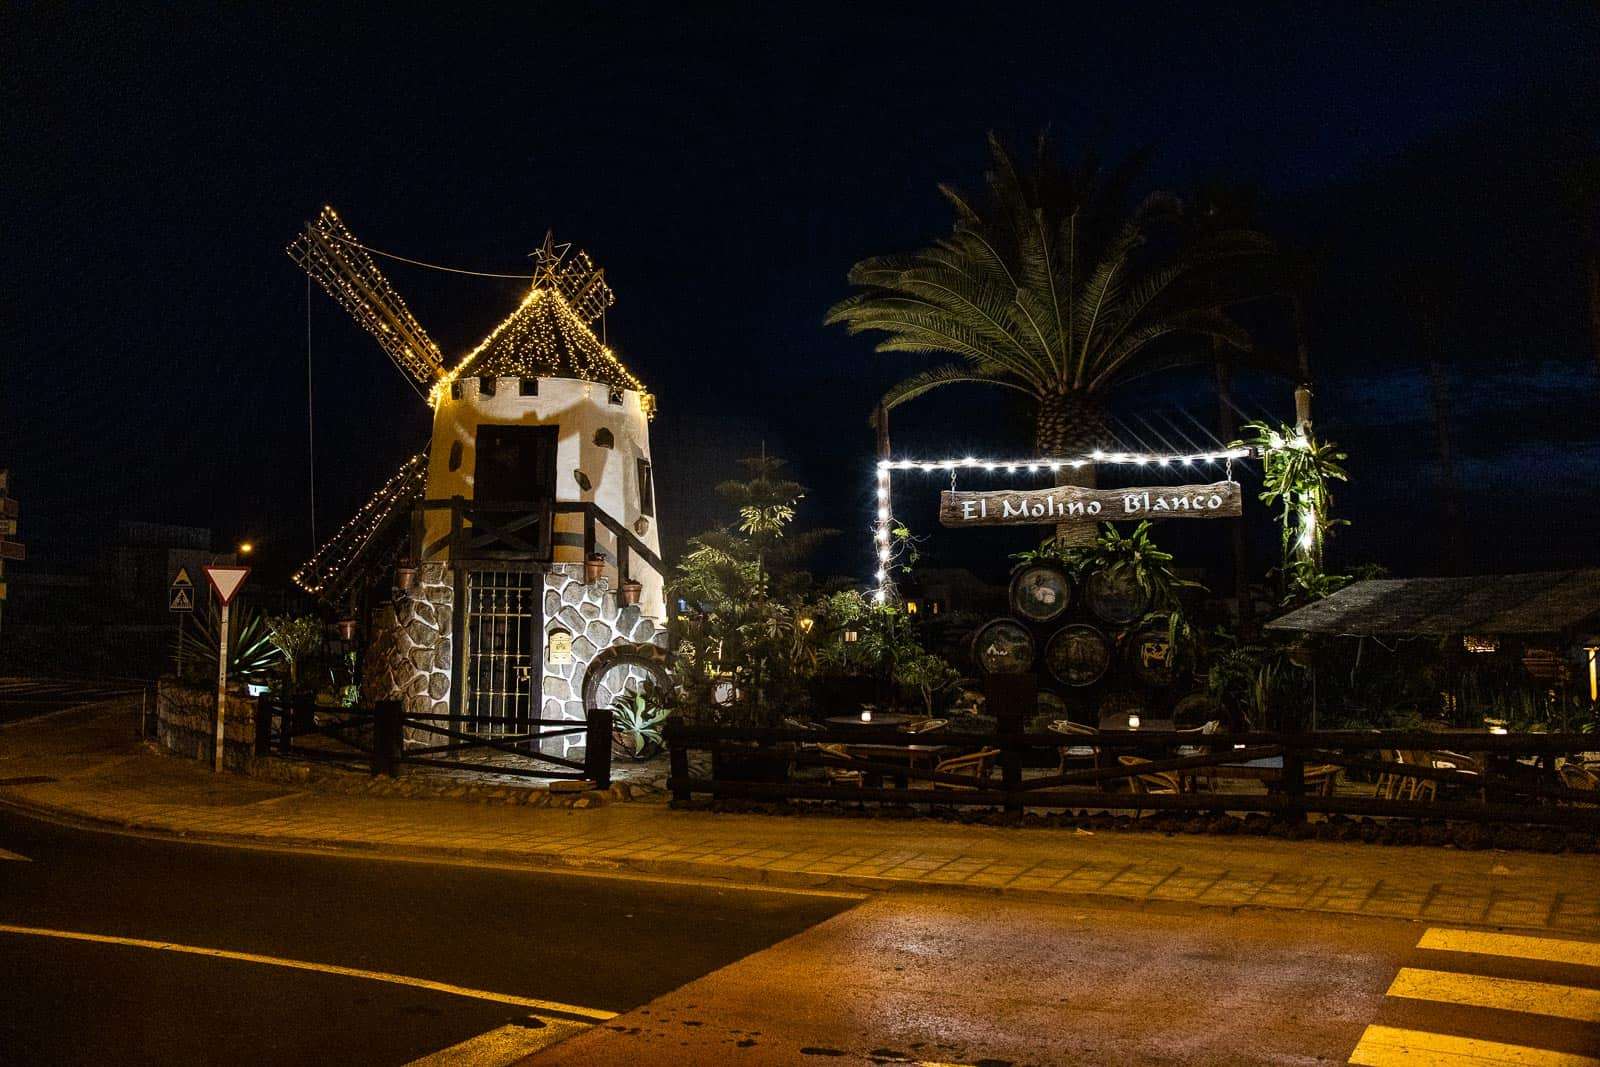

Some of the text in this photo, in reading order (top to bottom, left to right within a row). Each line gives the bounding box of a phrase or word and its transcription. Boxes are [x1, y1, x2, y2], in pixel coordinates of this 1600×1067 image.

[961, 491, 1222, 519] El Molino Blanco
